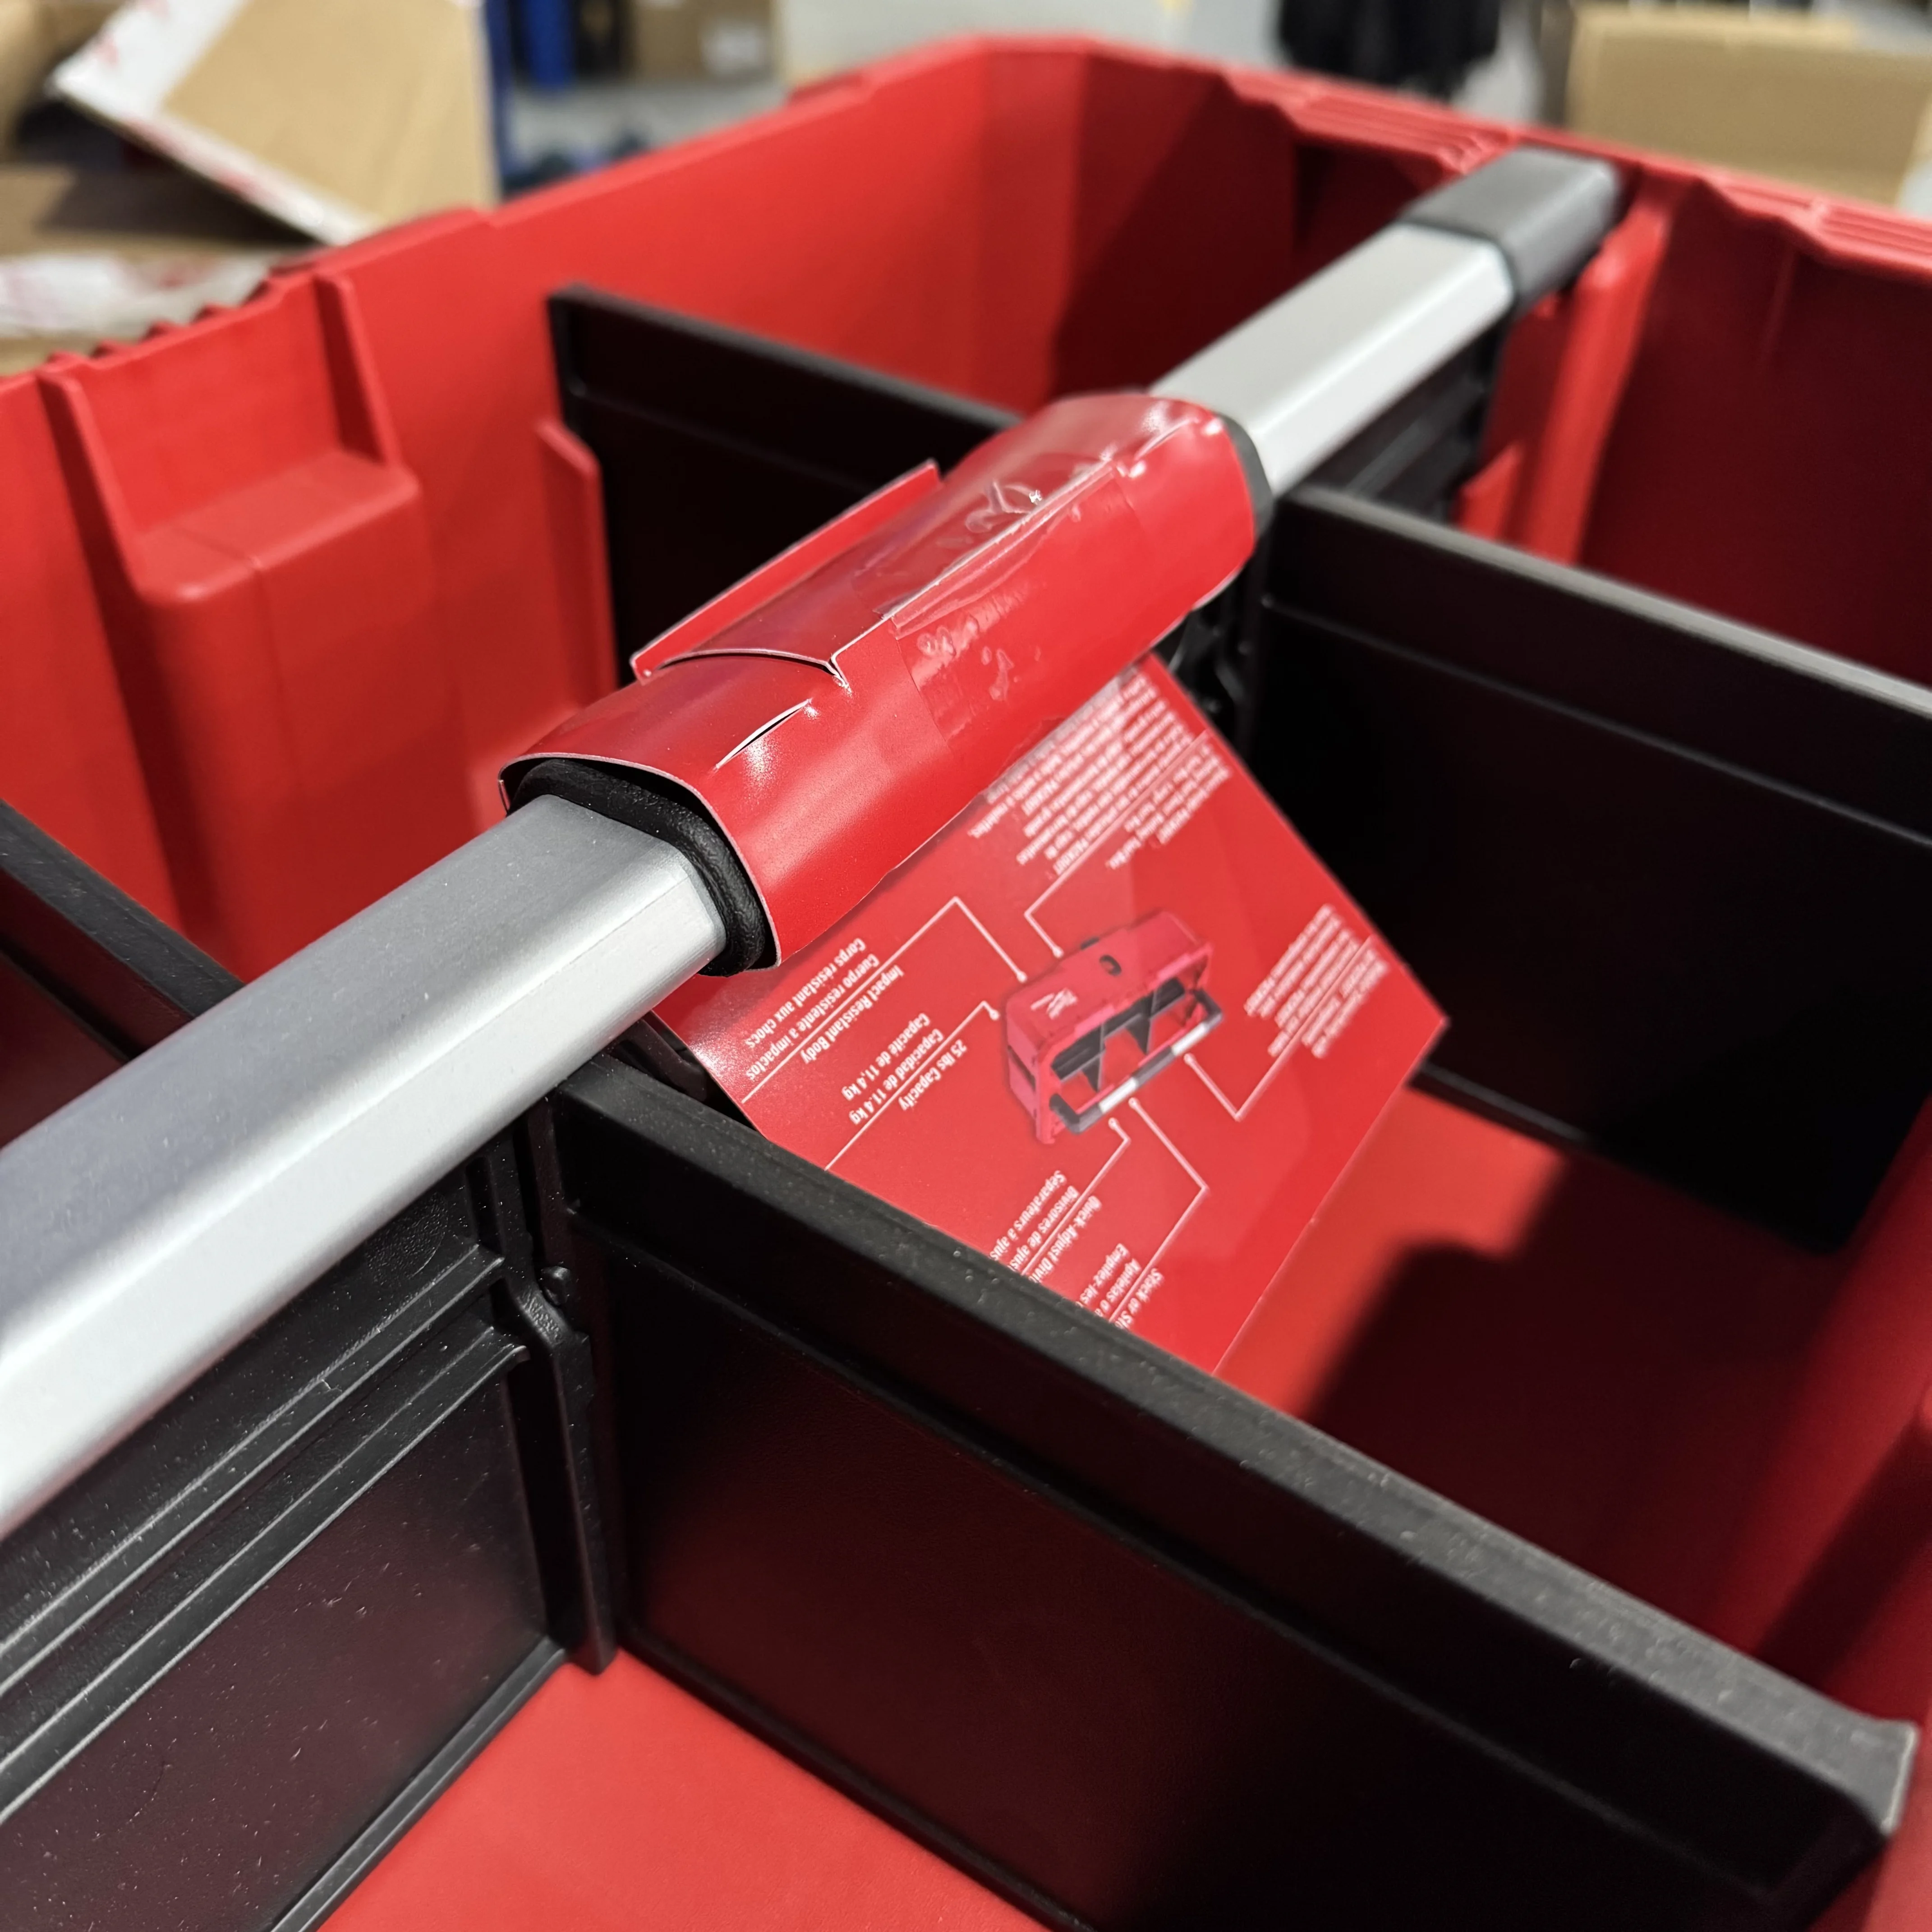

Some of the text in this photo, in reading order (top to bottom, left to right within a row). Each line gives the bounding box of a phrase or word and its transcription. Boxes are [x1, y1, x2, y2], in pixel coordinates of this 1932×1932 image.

[743, 938, 866, 1051] Corps résistant aux chocs
[744, 954, 880, 1082] Cuerpo resistente a impactos
[800, 965, 904, 1064] Impact Resistant Body
[842, 1013, 930, 1101] Capacité de 11,4 kg
[849, 1029, 944, 1125] Capacidad de 11.4 kg
[898, 1040, 967, 1110] 25 lbs Capacity
[1027, 1231, 1042, 1248] de
[1038, 1186, 1079, 1234] Divisores
[1047, 1196, 1101, 1263] Quick-Adjust
[1080, 1243, 1129, 1305] Empilez-les
[1127, 1297, 1141, 1315] or
[1135, 1268, 1163, 1302] Stack
